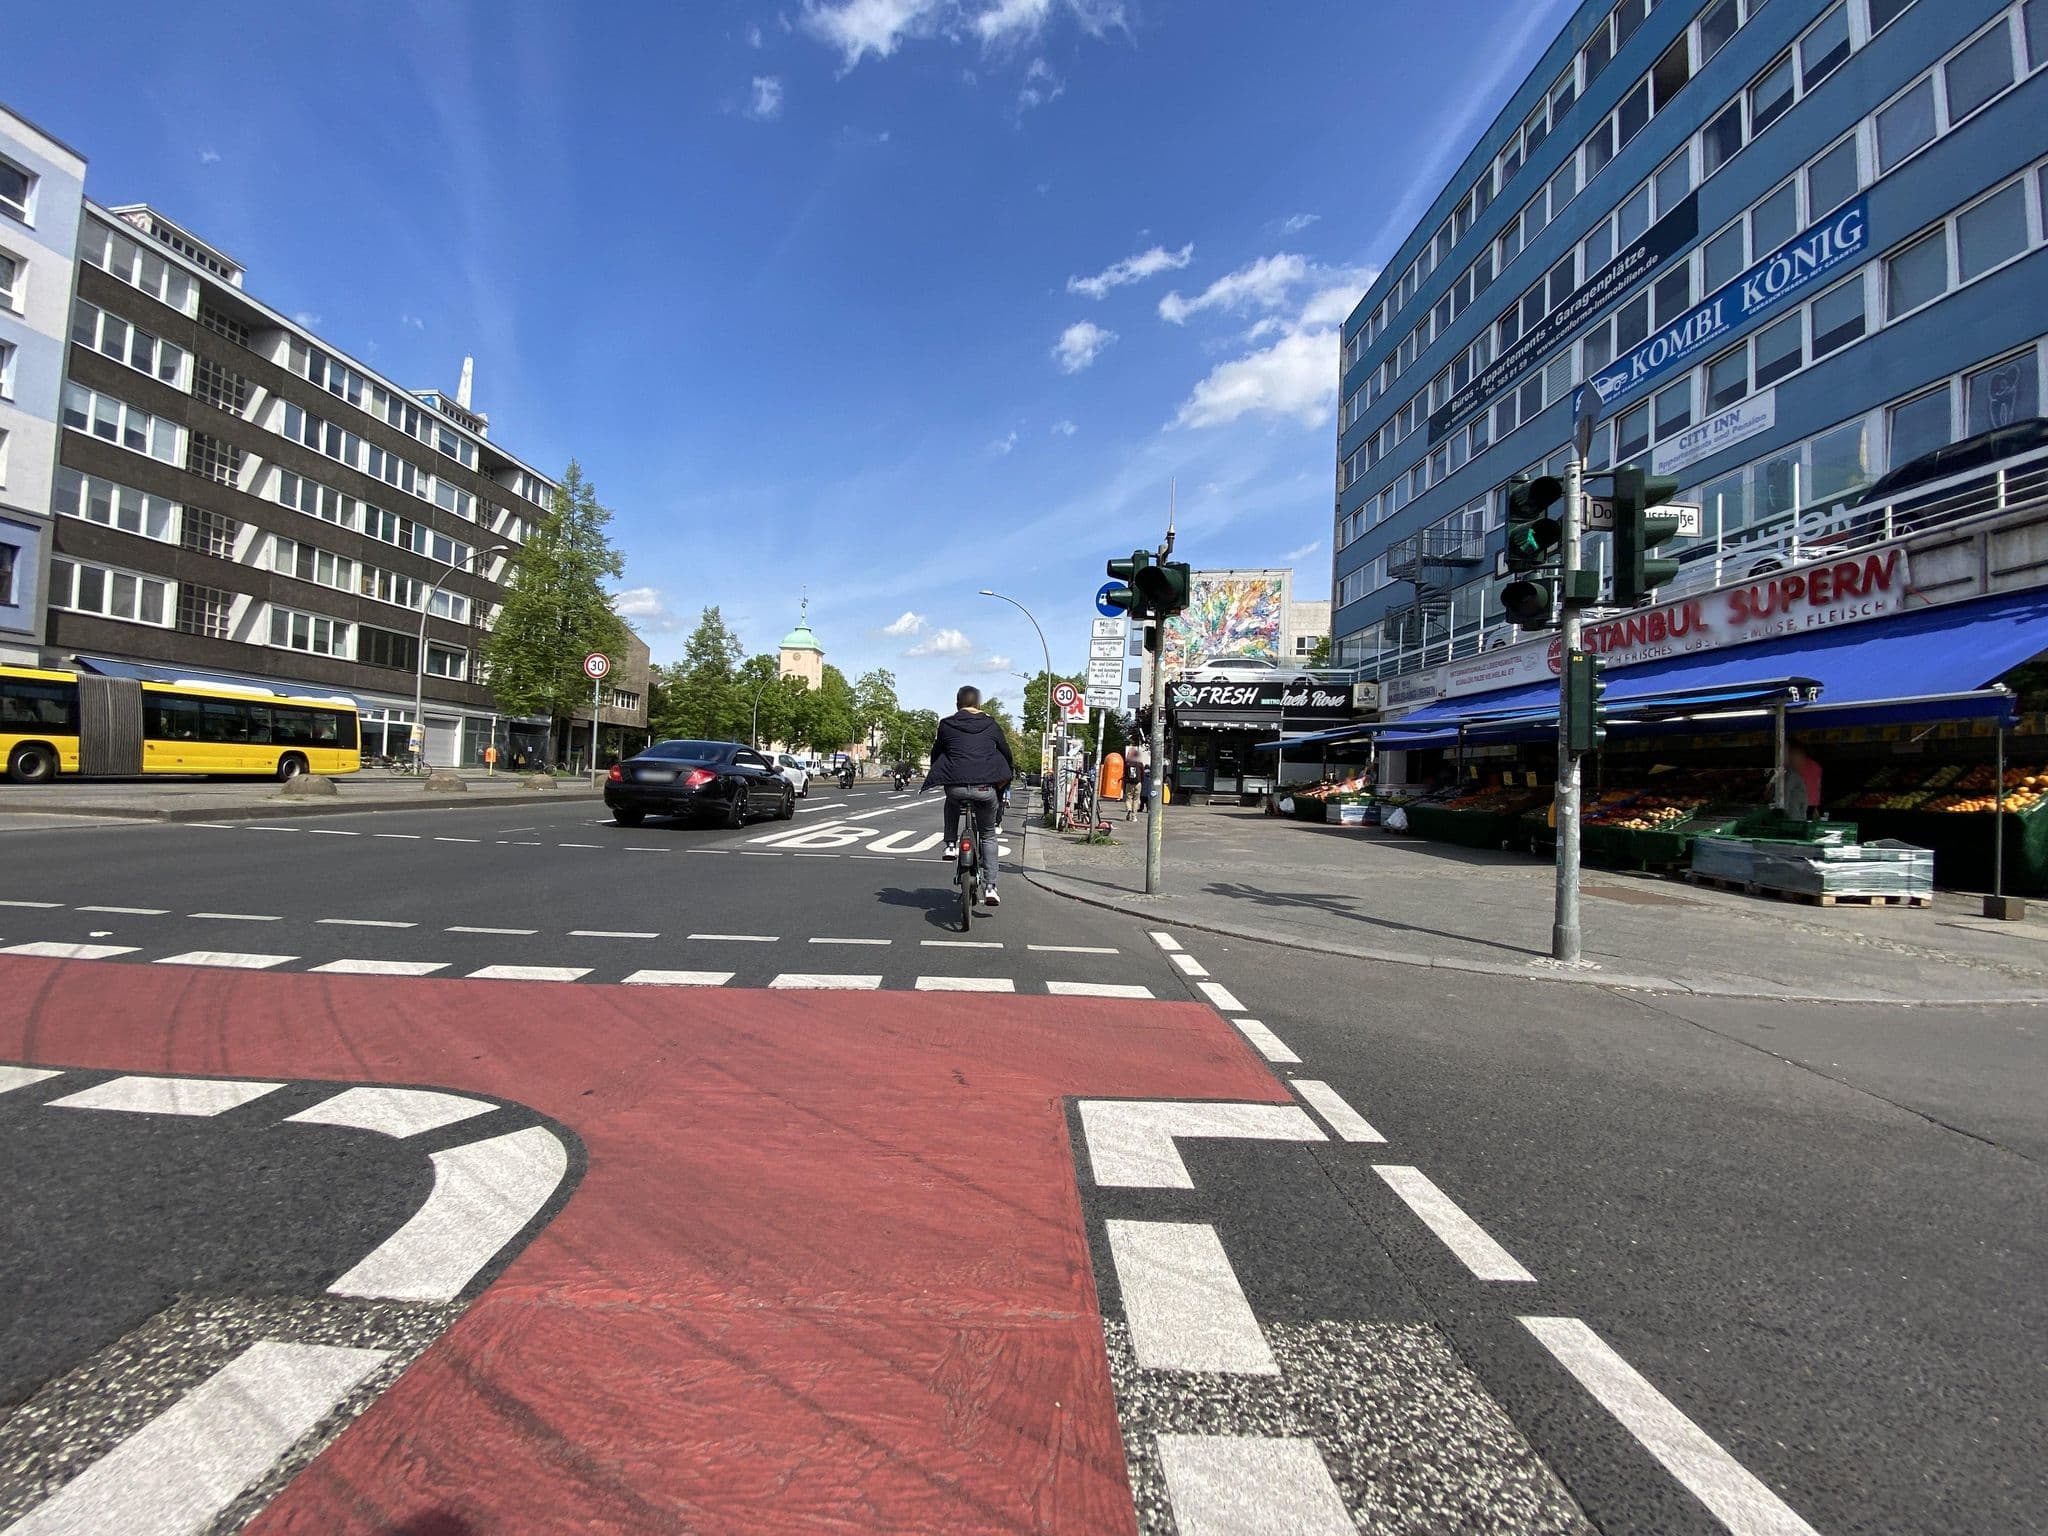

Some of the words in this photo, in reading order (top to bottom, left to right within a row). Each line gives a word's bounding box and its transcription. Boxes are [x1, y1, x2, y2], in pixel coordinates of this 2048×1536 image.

[1630, 298, 1724, 382] KOMBI
[1741, 209, 1864, 312] KÖNIG
[1451, 388, 1474, 413] Büros
[1480, 329, 1546, 390] Appartements
[1554, 246, 1646, 327] Garagenplätze
[1678, 423, 1712, 450] CITY
[1713, 409, 1741, 434] INN
[1580, 600, 1710, 655] STANBUL
[589, 658, 605, 672] 30
[1058, 689, 1072, 700] 30
[1196, 686, 1260, 705] FRESH
[1311, 690, 1346, 707] Rose
